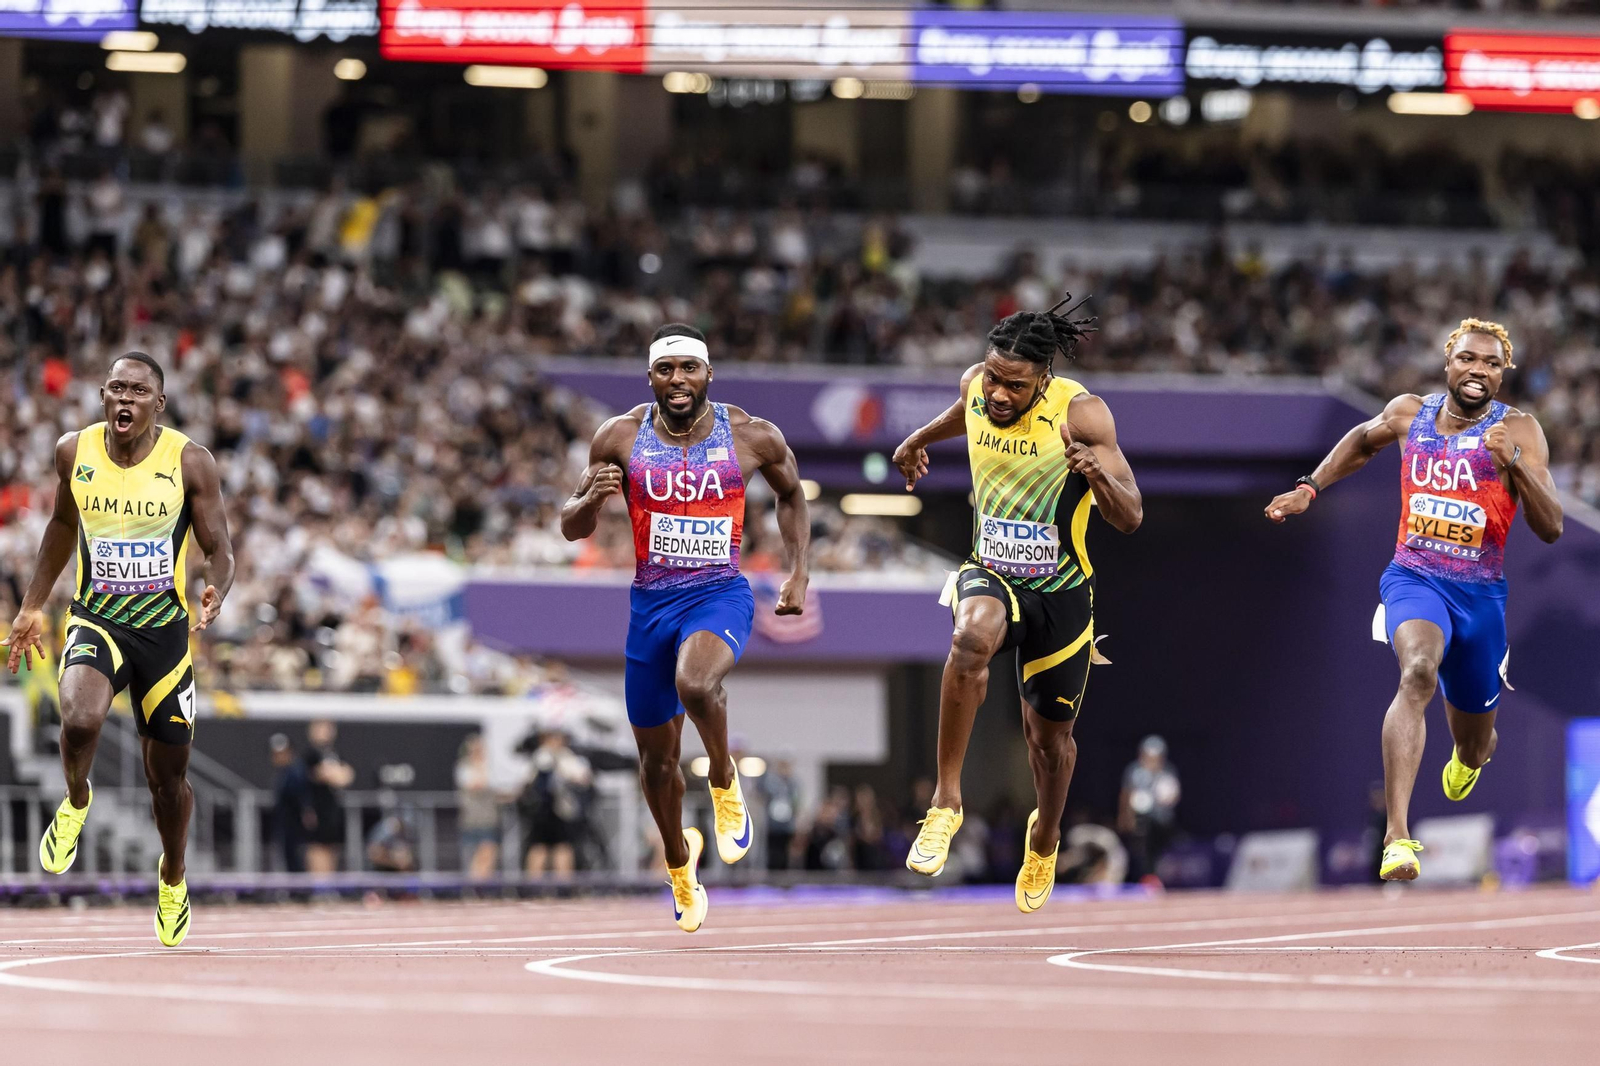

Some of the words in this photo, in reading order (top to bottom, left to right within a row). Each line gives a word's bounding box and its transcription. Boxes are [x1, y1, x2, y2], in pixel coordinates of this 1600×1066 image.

[976, 430, 1039, 457] JAMAICA
[1411, 453, 1478, 492] USA
[645, 469, 724, 502] USA
[82, 495, 168, 517] JAMAICA
[1427, 497, 1481, 524] TDK
[673, 518, 727, 536] TDK
[996, 521, 1052, 541] TDK
[111, 540, 168, 558] TDK
[653, 535, 728, 556] BEDNAREK
[983, 537, 1054, 561] THOMPSON
[95, 558, 169, 579] SEVILLE
